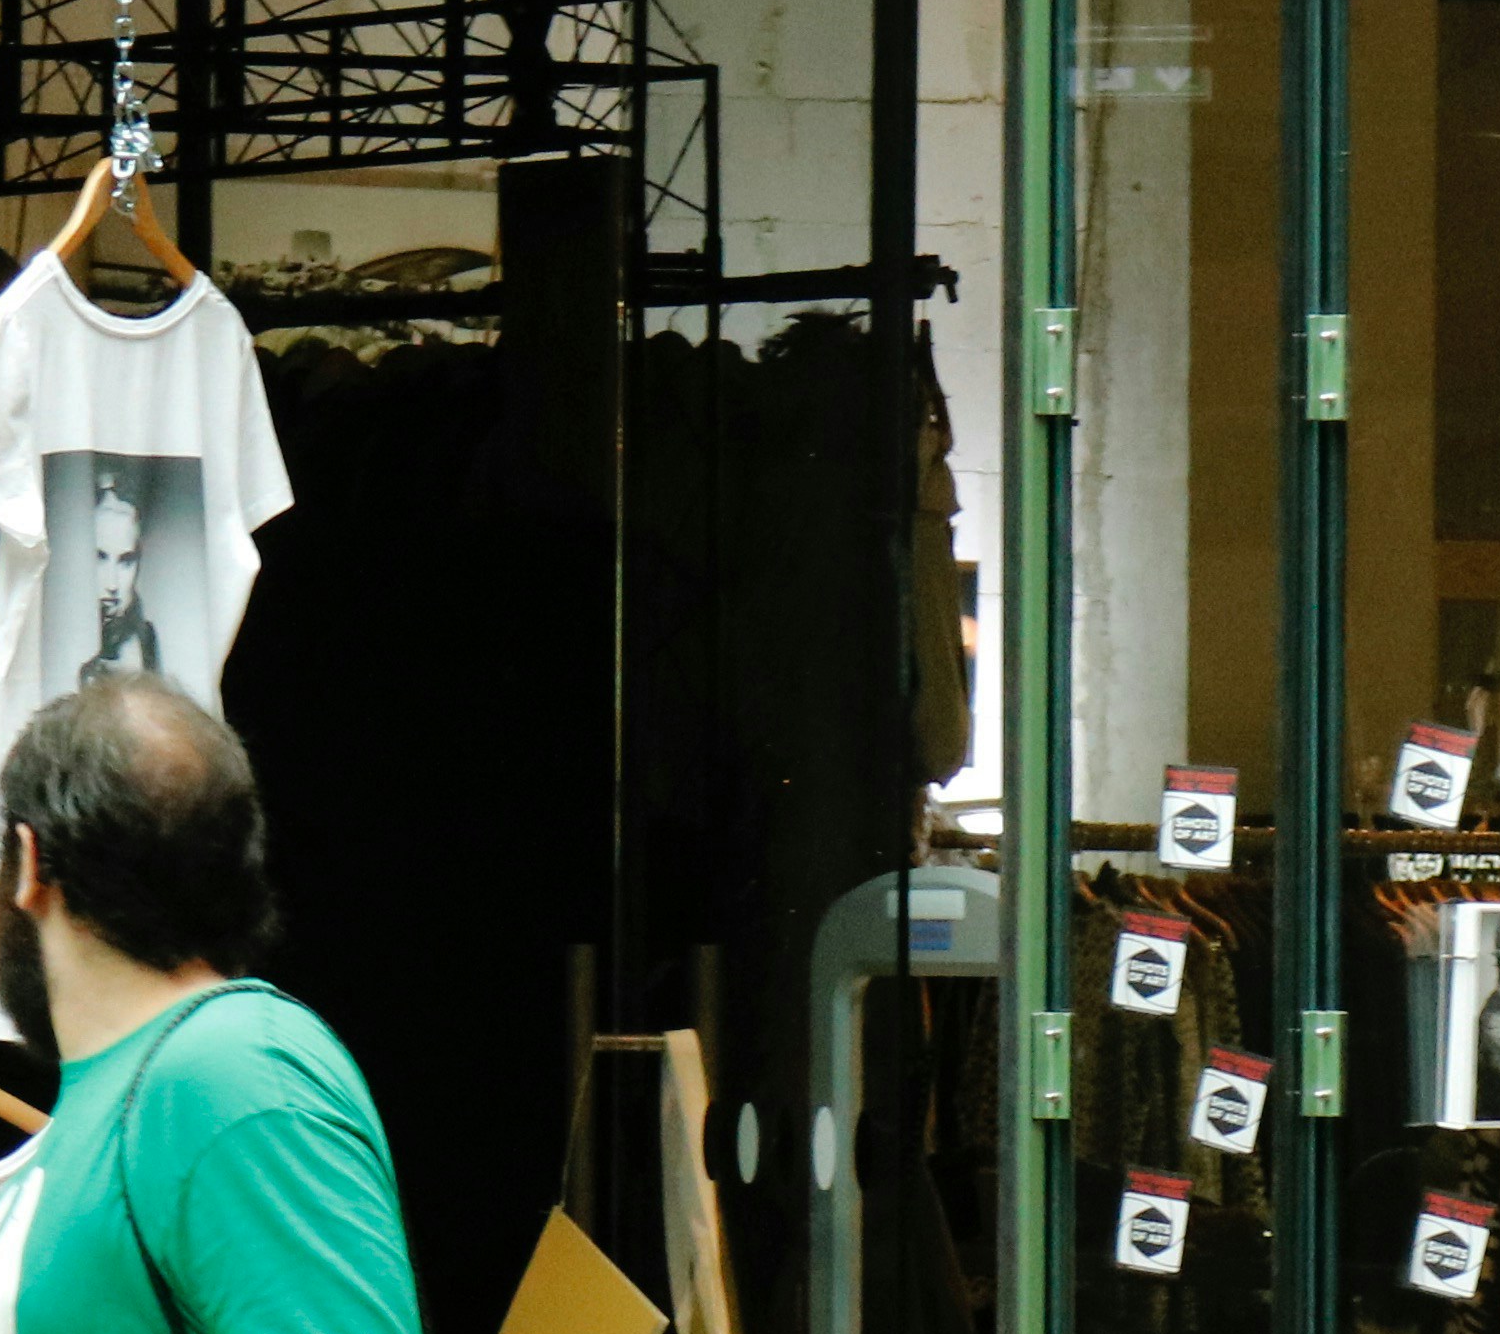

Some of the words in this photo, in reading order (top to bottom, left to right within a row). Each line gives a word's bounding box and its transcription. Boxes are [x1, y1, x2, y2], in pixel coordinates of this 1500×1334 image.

[1410, 768, 1451, 790] SHOTS
[1408, 782, 1425, 795] OF
[1423, 786, 1449, 801] ART
[1176, 814, 1217, 830] SHOTS
[1175, 828, 1192, 840] OF
[1191, 829, 1216, 842] ART
[1129, 957, 1169, 976] SHOTS
[1127, 971, 1144, 984] OF
[1142, 974, 1167, 988] ART
[1209, 1093, 1248, 1115] SHOTS
[1207, 1107, 1224, 1120] OF
[1221, 1111, 1246, 1127] ART
[1132, 1216, 1172, 1235] SHOTS
[1131, 1230, 1147, 1243] OF
[1146, 1233, 1170, 1247] ART
[1428, 1238, 1468, 1260] SHOTS
[1425, 1252, 1443, 1265] OF
[1441, 1256, 1467, 1271] ART
